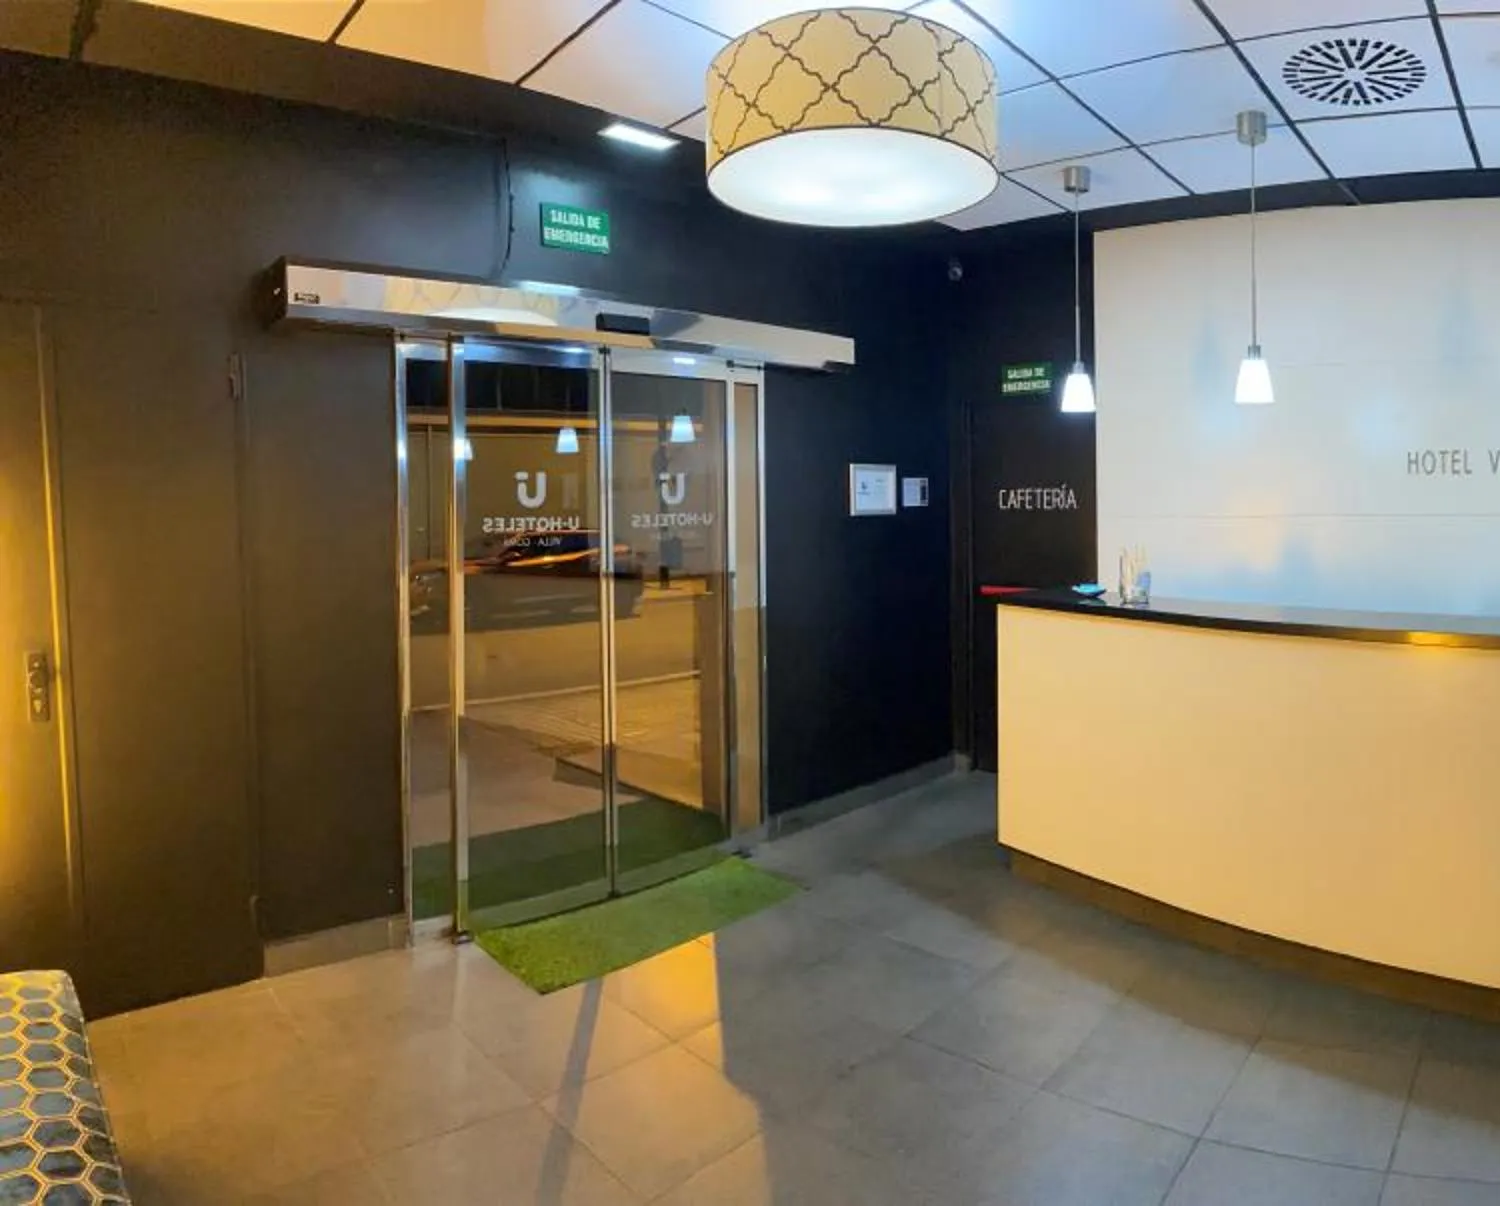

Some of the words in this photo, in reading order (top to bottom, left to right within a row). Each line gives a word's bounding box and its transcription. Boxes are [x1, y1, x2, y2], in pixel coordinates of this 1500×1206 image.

[551, 209, 585, 227] SALIDA
[586, 215, 602, 229] DE
[543, 226, 609, 249] EMERGENCIA
[1406, 450, 1473, 475] HOTEL
[999, 484, 1077, 510] CAFETERÍA
